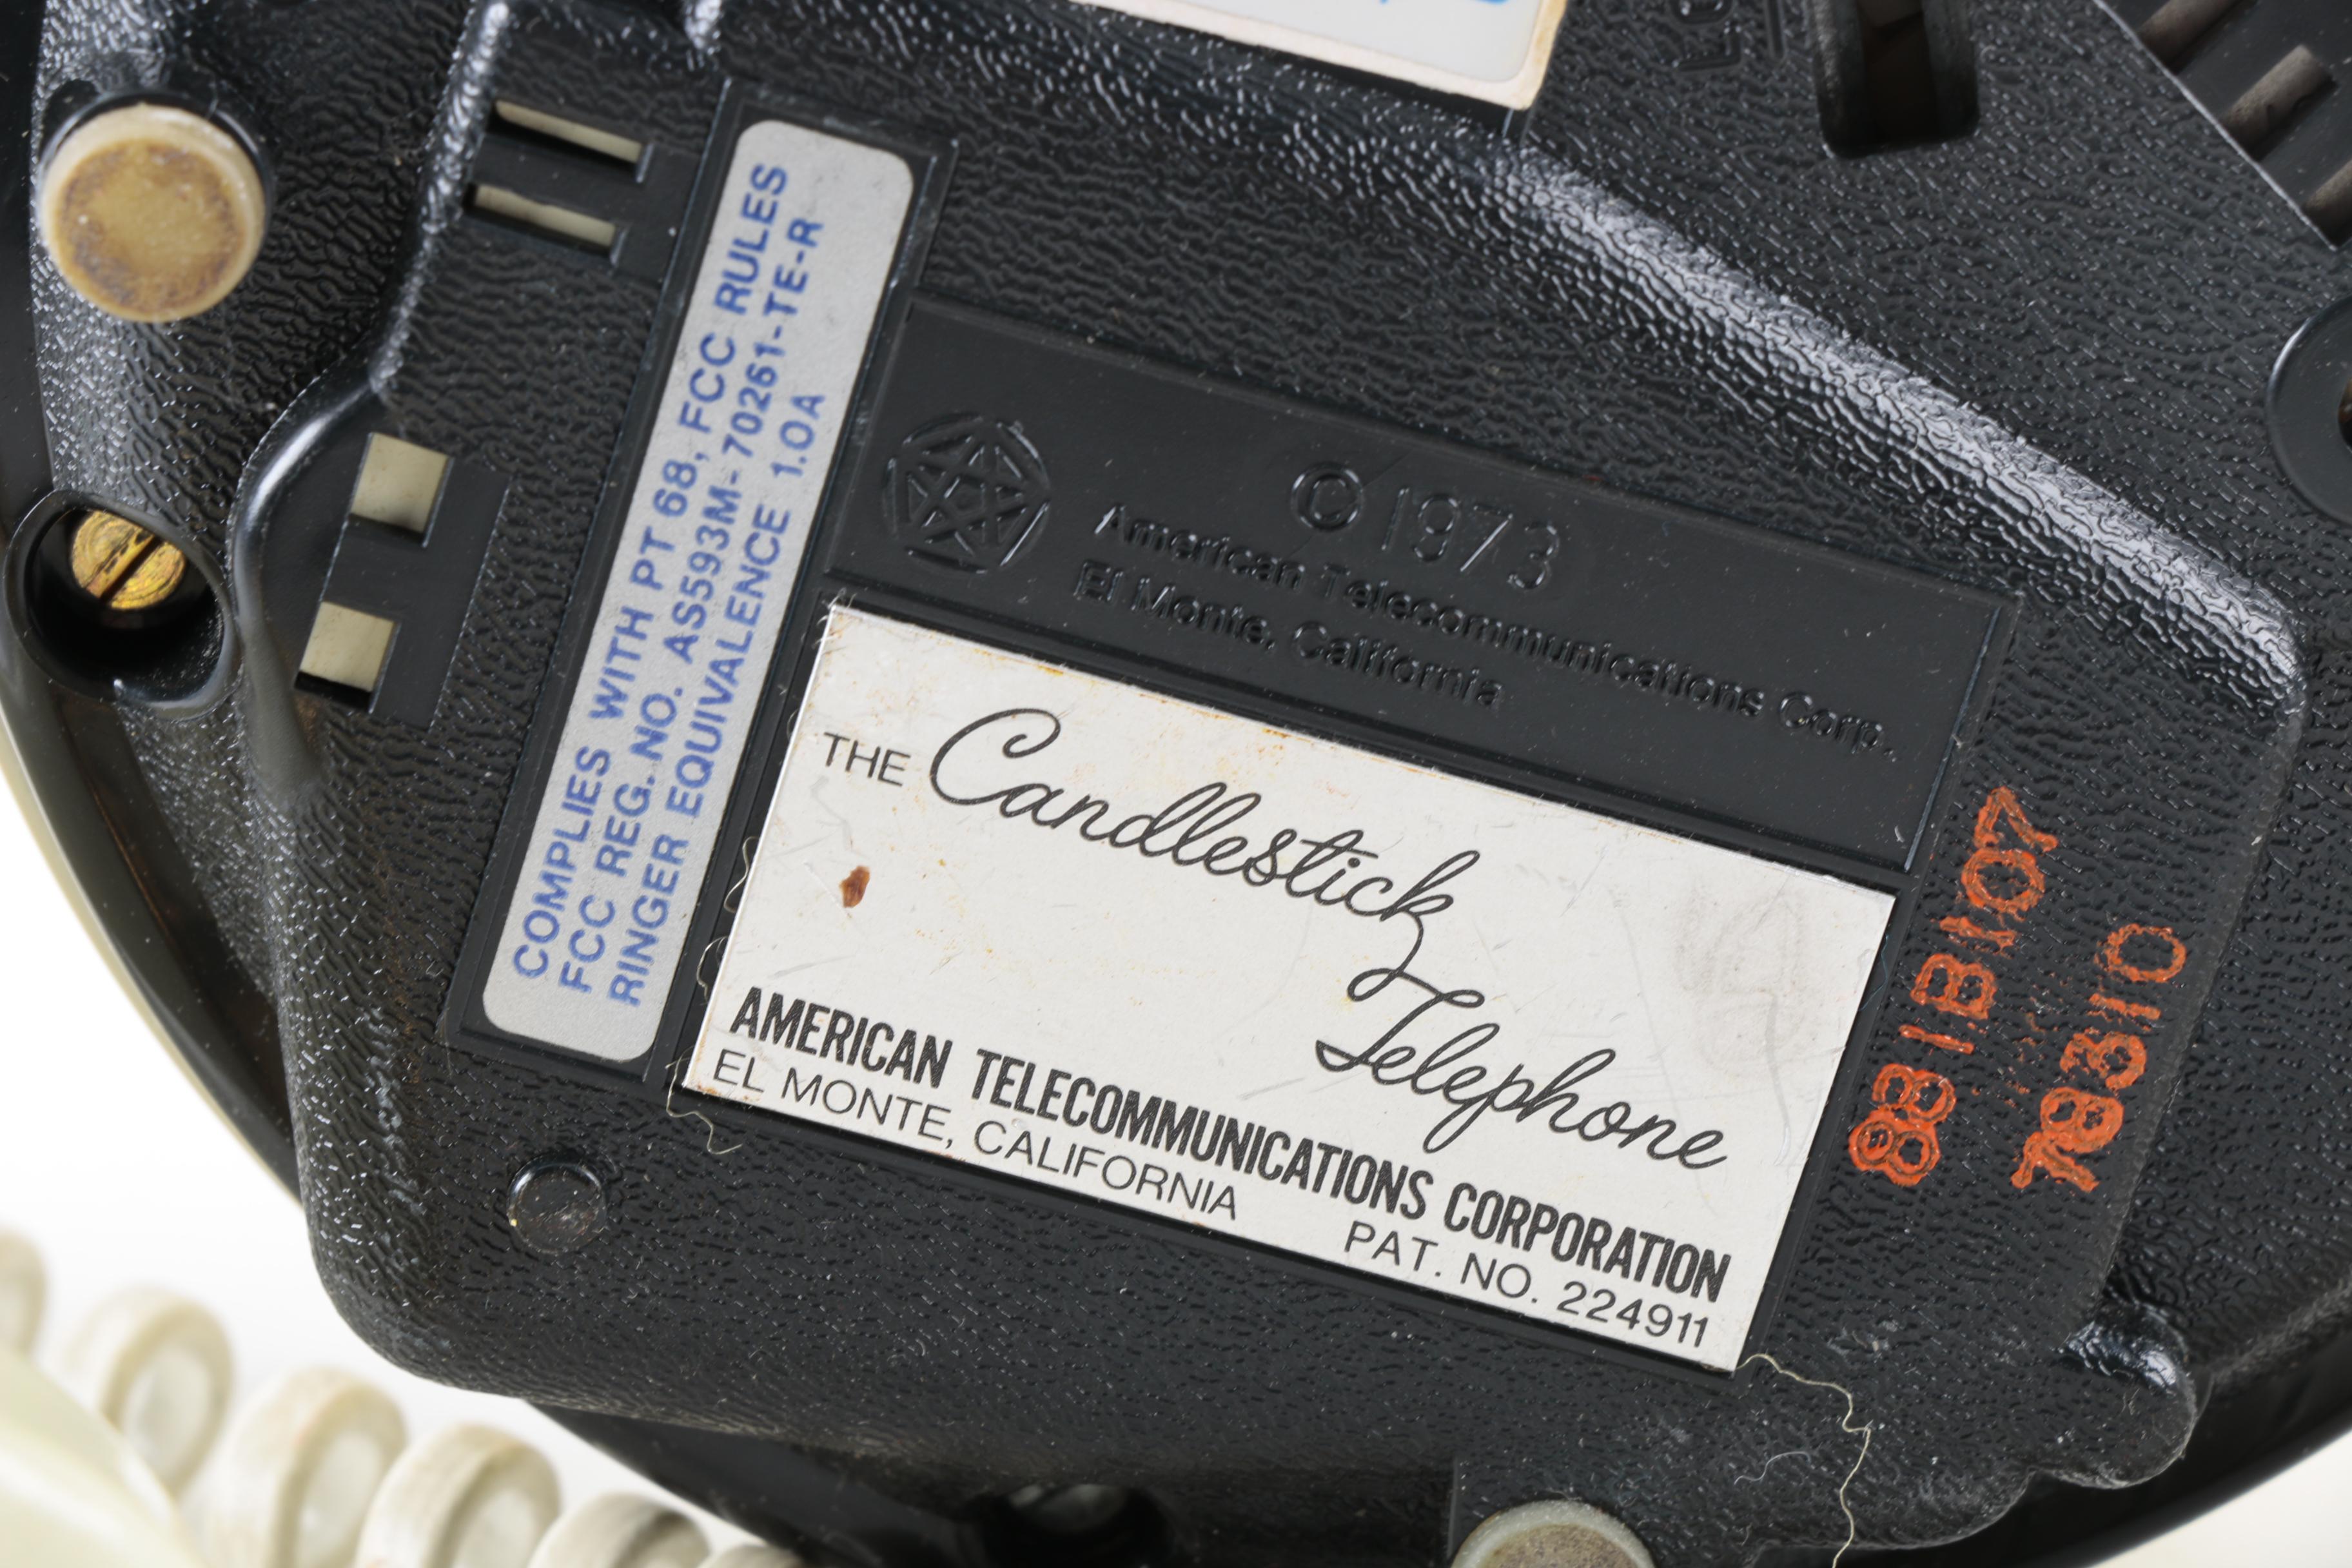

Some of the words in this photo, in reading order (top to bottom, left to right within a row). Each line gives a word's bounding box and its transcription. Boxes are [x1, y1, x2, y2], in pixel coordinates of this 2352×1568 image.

[714, 163, 788, 315] RULES
[679, 333, 738, 433] FCC
[630, 526, 676, 591] PT
[654, 451, 710, 518] 68,
[589, 605, 654, 721] WITH
[1073, 557, 1124, 605] El
[1130, 576, 1277, 651] Monte,
[1292, 620, 1505, 709] California
[1093, 502, 1307, 591] American
[1322, 560, 1765, 717] Telecommunications
[1778, 691, 1897, 763] Corp.
[607, 834, 689, 1006] RINGER
[665, 505, 791, 818] EQUIVALENCE
[513, 746, 611, 978] COMPLIES
[823, 732, 912, 787] THE
[930, 707, 1480, 967] Candlestick
[559, 894, 616, 994] FCC
[713, 1049, 765, 1093] EL
[782, 1068, 953, 1150] MONTE,
[974, 1120, 1237, 1220] CALIFORNIA
[1316, 968, 1727, 1169] Telephone
[729, 987, 953, 1088] AMERICAN
[971, 1048, 1434, 1220] TELECOMMUNICATIONS
[1443, 1183, 1730, 1304] CORPORATION
[1344, 1221, 1441, 1277] PAT.
[1461, 1252, 1539, 1303] NO.
[1557, 1281, 1710, 1347] 224911
